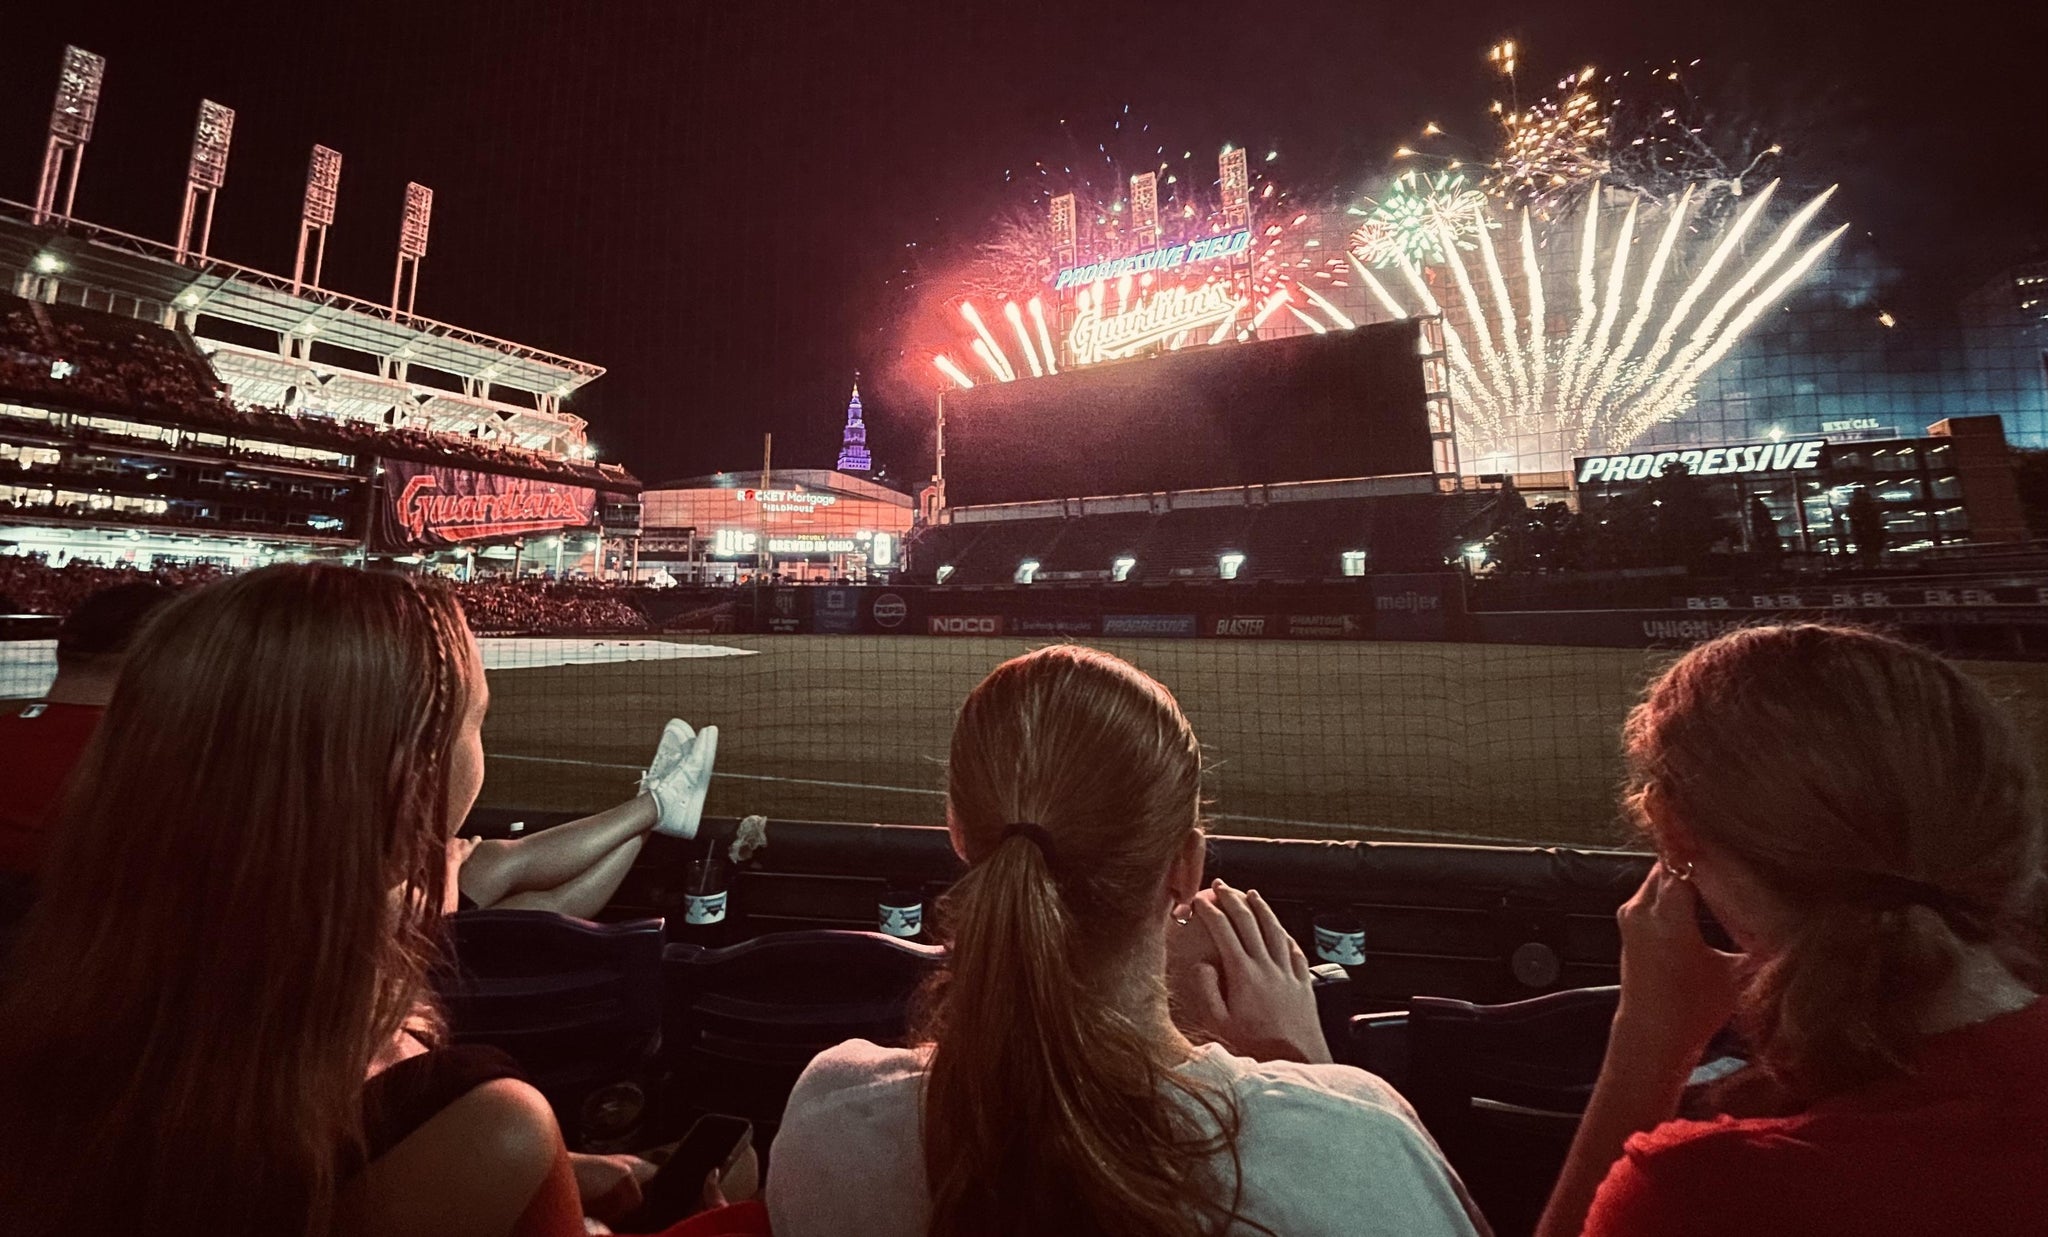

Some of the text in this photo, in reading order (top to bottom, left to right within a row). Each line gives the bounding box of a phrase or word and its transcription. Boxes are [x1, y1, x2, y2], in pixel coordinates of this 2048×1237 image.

[1055, 230, 1251, 290] PROGRESSIVE FIELD
[1578, 440, 1825, 484] PROGRESSIVE
[737, 489, 836, 506] ROCKET Mortgage
[397, 474, 589, 543] Guardians
[768, 540, 855, 553] BREWED IN OHIO
[1375, 591, 1438, 614] meijer
[932, 617, 995, 633] NOCO
[1103, 618, 1189, 634] PROGRESSIVE
[1216, 619, 1265, 635] BLASTER
[1643, 620, 1710, 639] UNION
